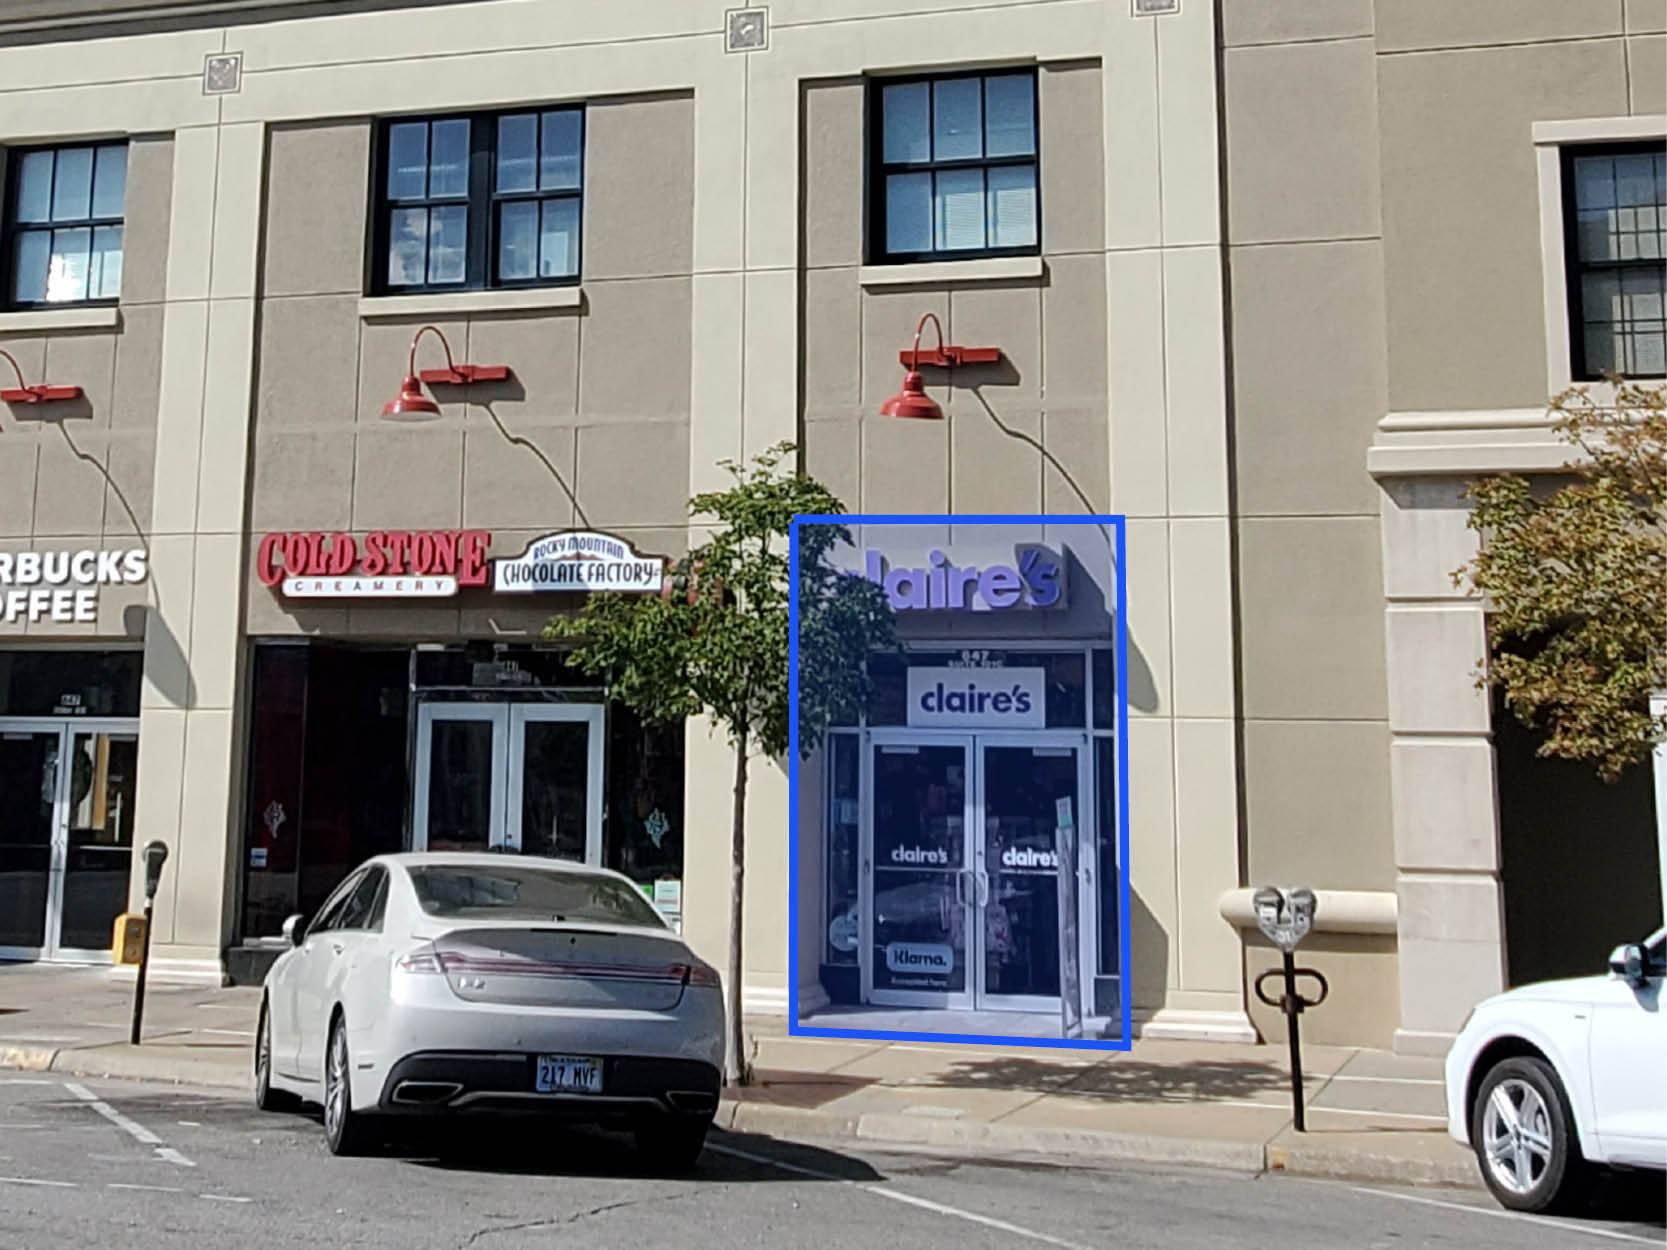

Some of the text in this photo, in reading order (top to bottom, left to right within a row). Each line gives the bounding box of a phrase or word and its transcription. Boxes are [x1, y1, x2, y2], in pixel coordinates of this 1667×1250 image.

[257, 529, 491, 586] COLD STONE
[533, 536, 625, 560] ROCKY MOUNTAIN
[0, 550, 147, 583] RBUCKS
[503, 561, 654, 587] CHOCOLATE FACTORY
[845, 549, 1061, 609] laire's
[294, 580, 445, 592] CREAMERY
[0, 589, 98, 621] FFEE
[920, 682, 1031, 713] claire's
[891, 844, 949, 864] claire's
[541, 1065, 567, 1085] 217
